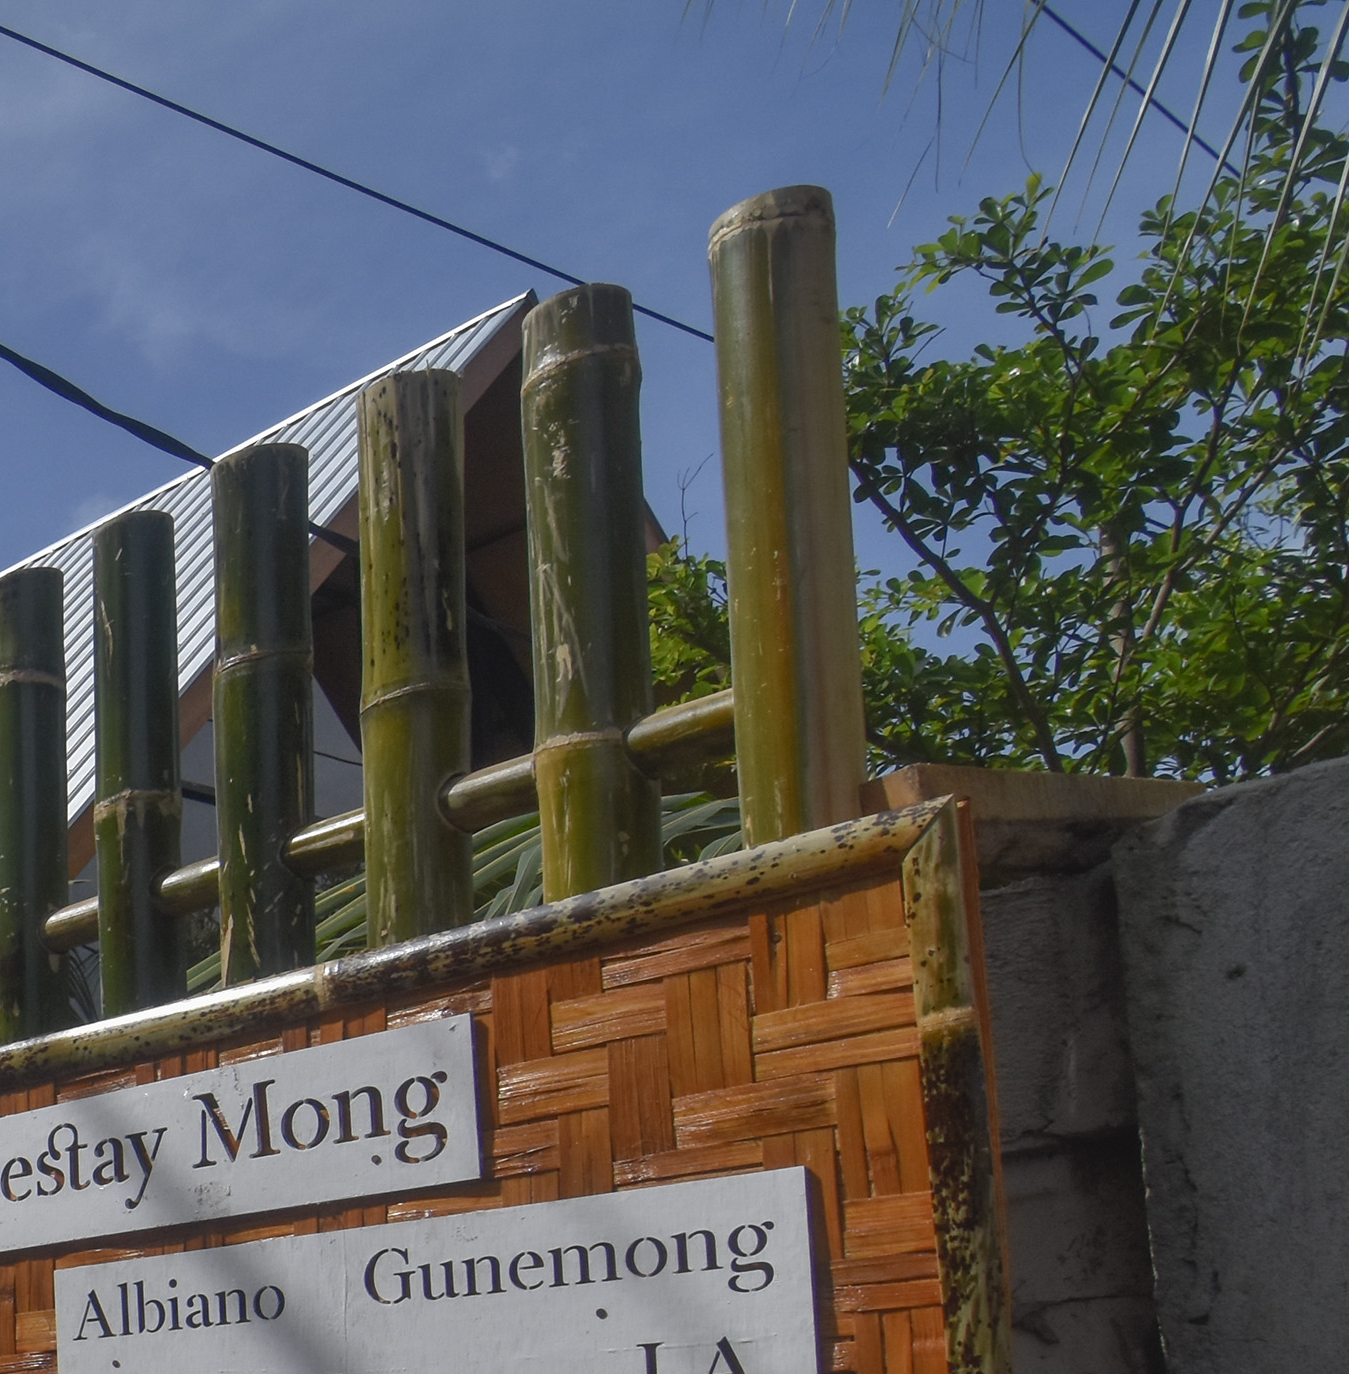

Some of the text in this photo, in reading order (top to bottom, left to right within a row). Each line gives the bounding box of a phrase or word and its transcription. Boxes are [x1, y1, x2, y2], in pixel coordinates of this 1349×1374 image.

[192, 1069, 448, 1170] Mong
[363, 1218, 775, 1306] Gunemong
[73, 1279, 287, 1343] Albiano
